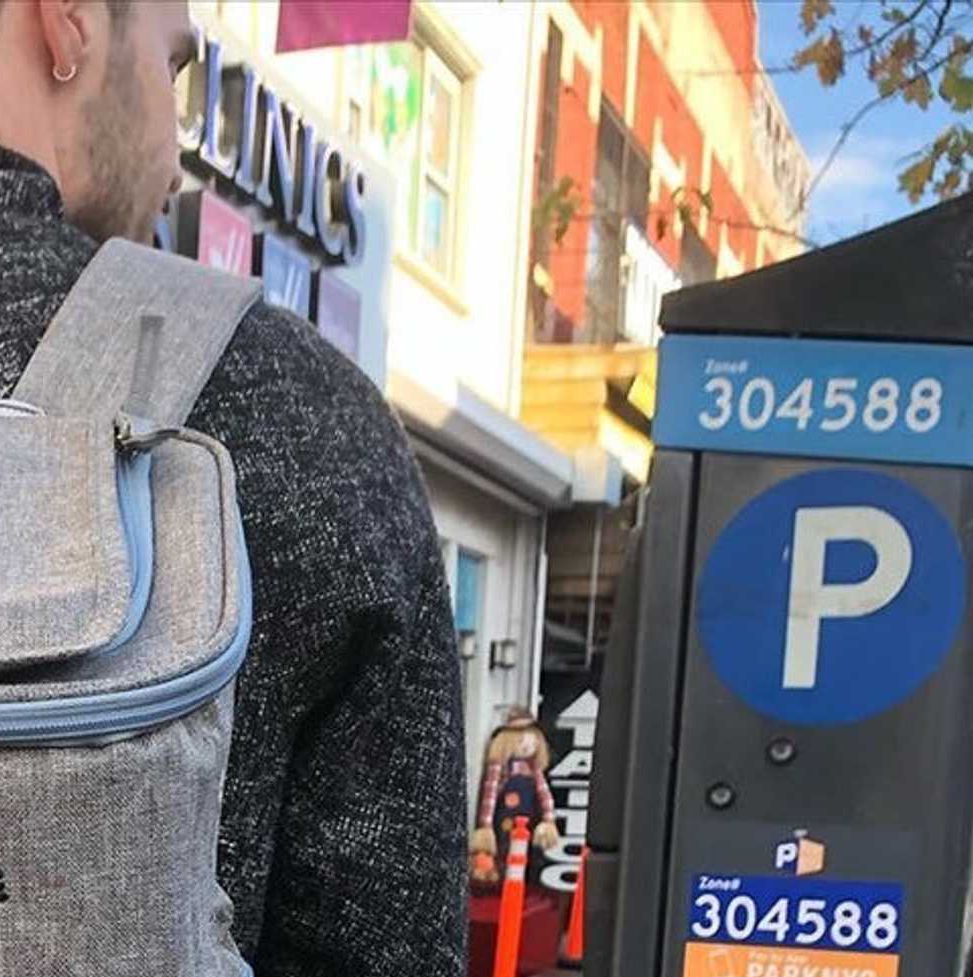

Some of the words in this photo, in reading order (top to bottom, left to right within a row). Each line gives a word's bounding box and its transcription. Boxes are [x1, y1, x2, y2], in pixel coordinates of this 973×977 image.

[699, 377, 943, 433] 304588
[783, 506, 912, 689] P
[691, 893, 898, 949] 304588
